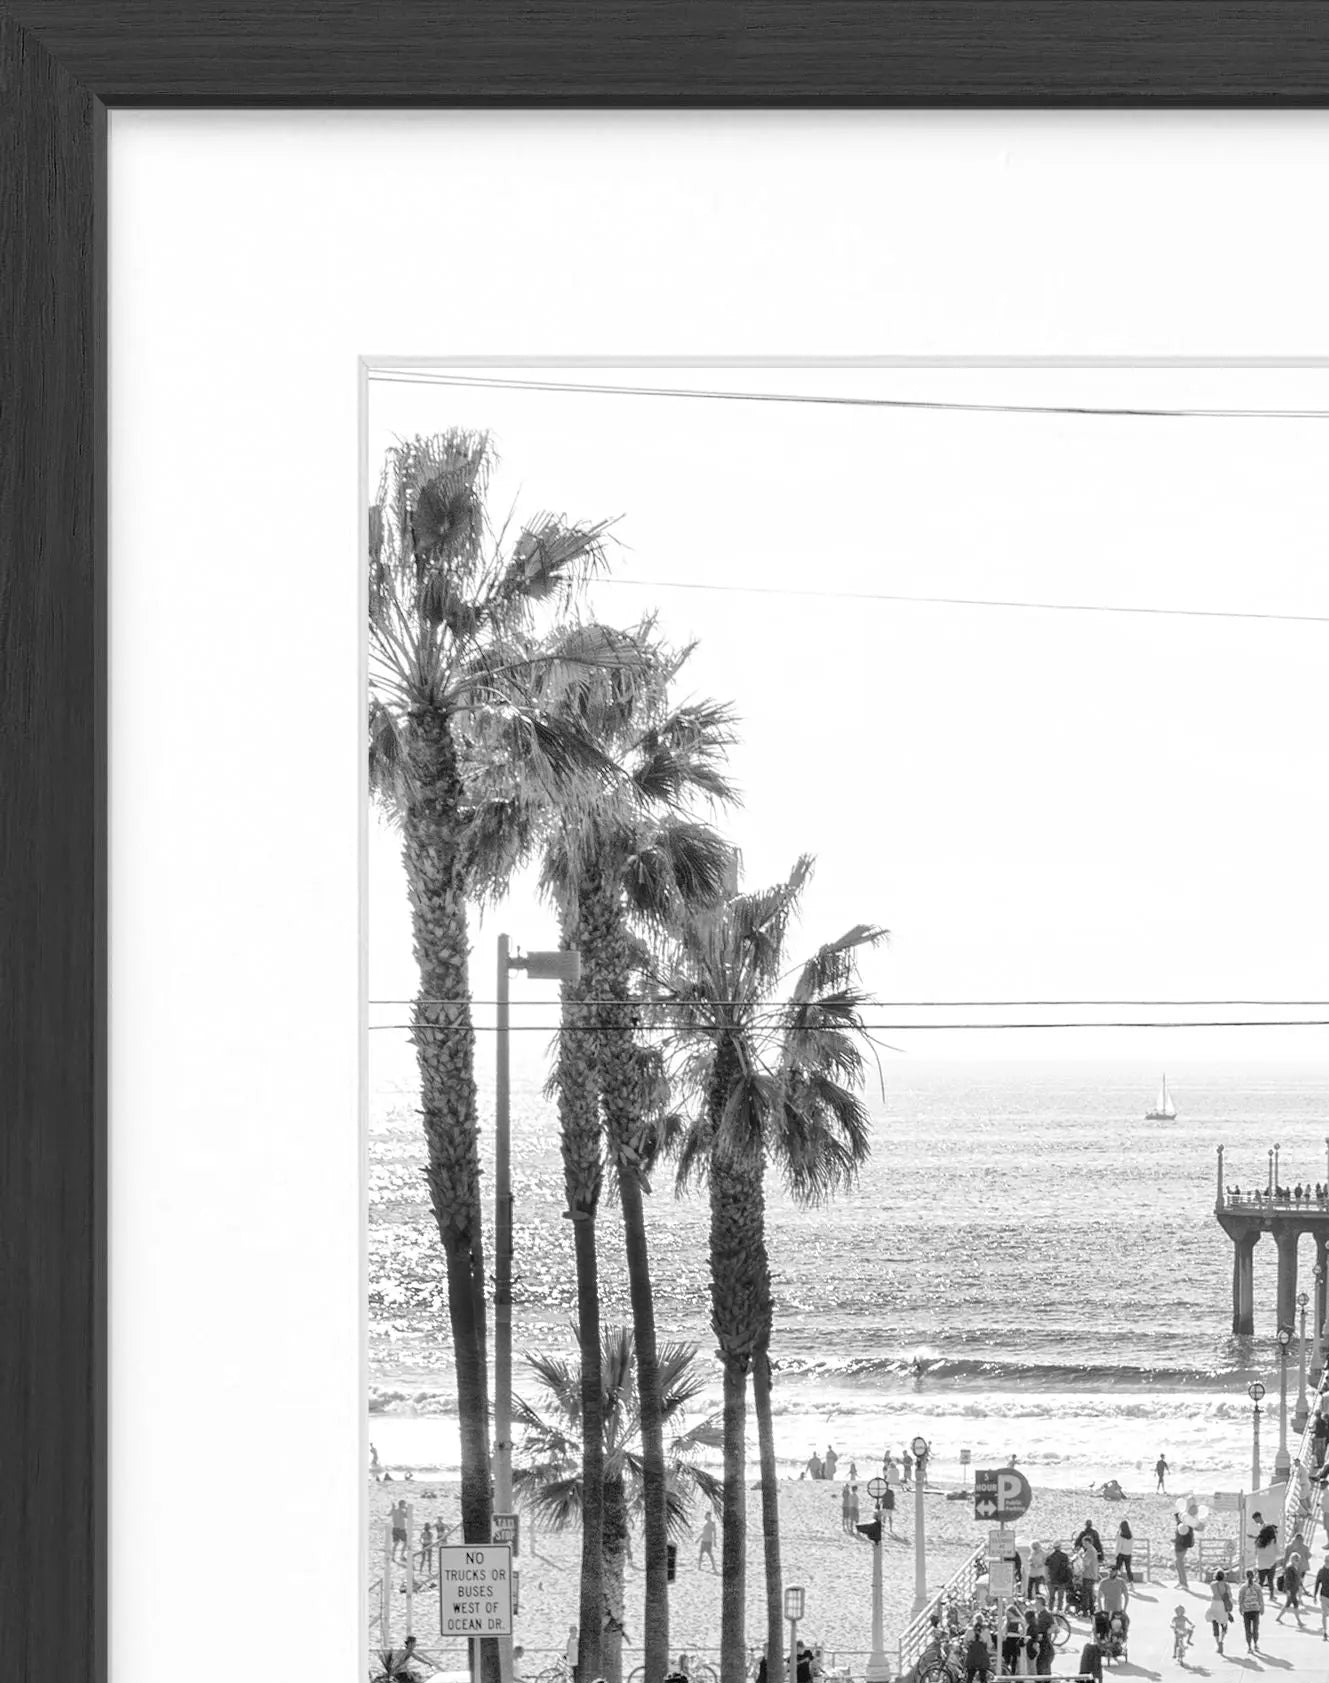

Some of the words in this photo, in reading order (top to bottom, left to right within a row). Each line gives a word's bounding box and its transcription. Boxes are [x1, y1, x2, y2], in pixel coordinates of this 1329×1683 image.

[976, 1483, 997, 1492] HOUR
[997, 1474, 1022, 1511] P
[465, 1552, 485, 1564] NO
[445, 1569, 486, 1581] TRUCKS
[491, 1569, 506, 1581] OR
[458, 1585, 494, 1597] BUSES
[453, 1602, 480, 1614] WEST
[485, 1602, 499, 1613] OF
[447, 1618, 482, 1631] OCEAN
[488, 1618, 506, 1630] DR.
